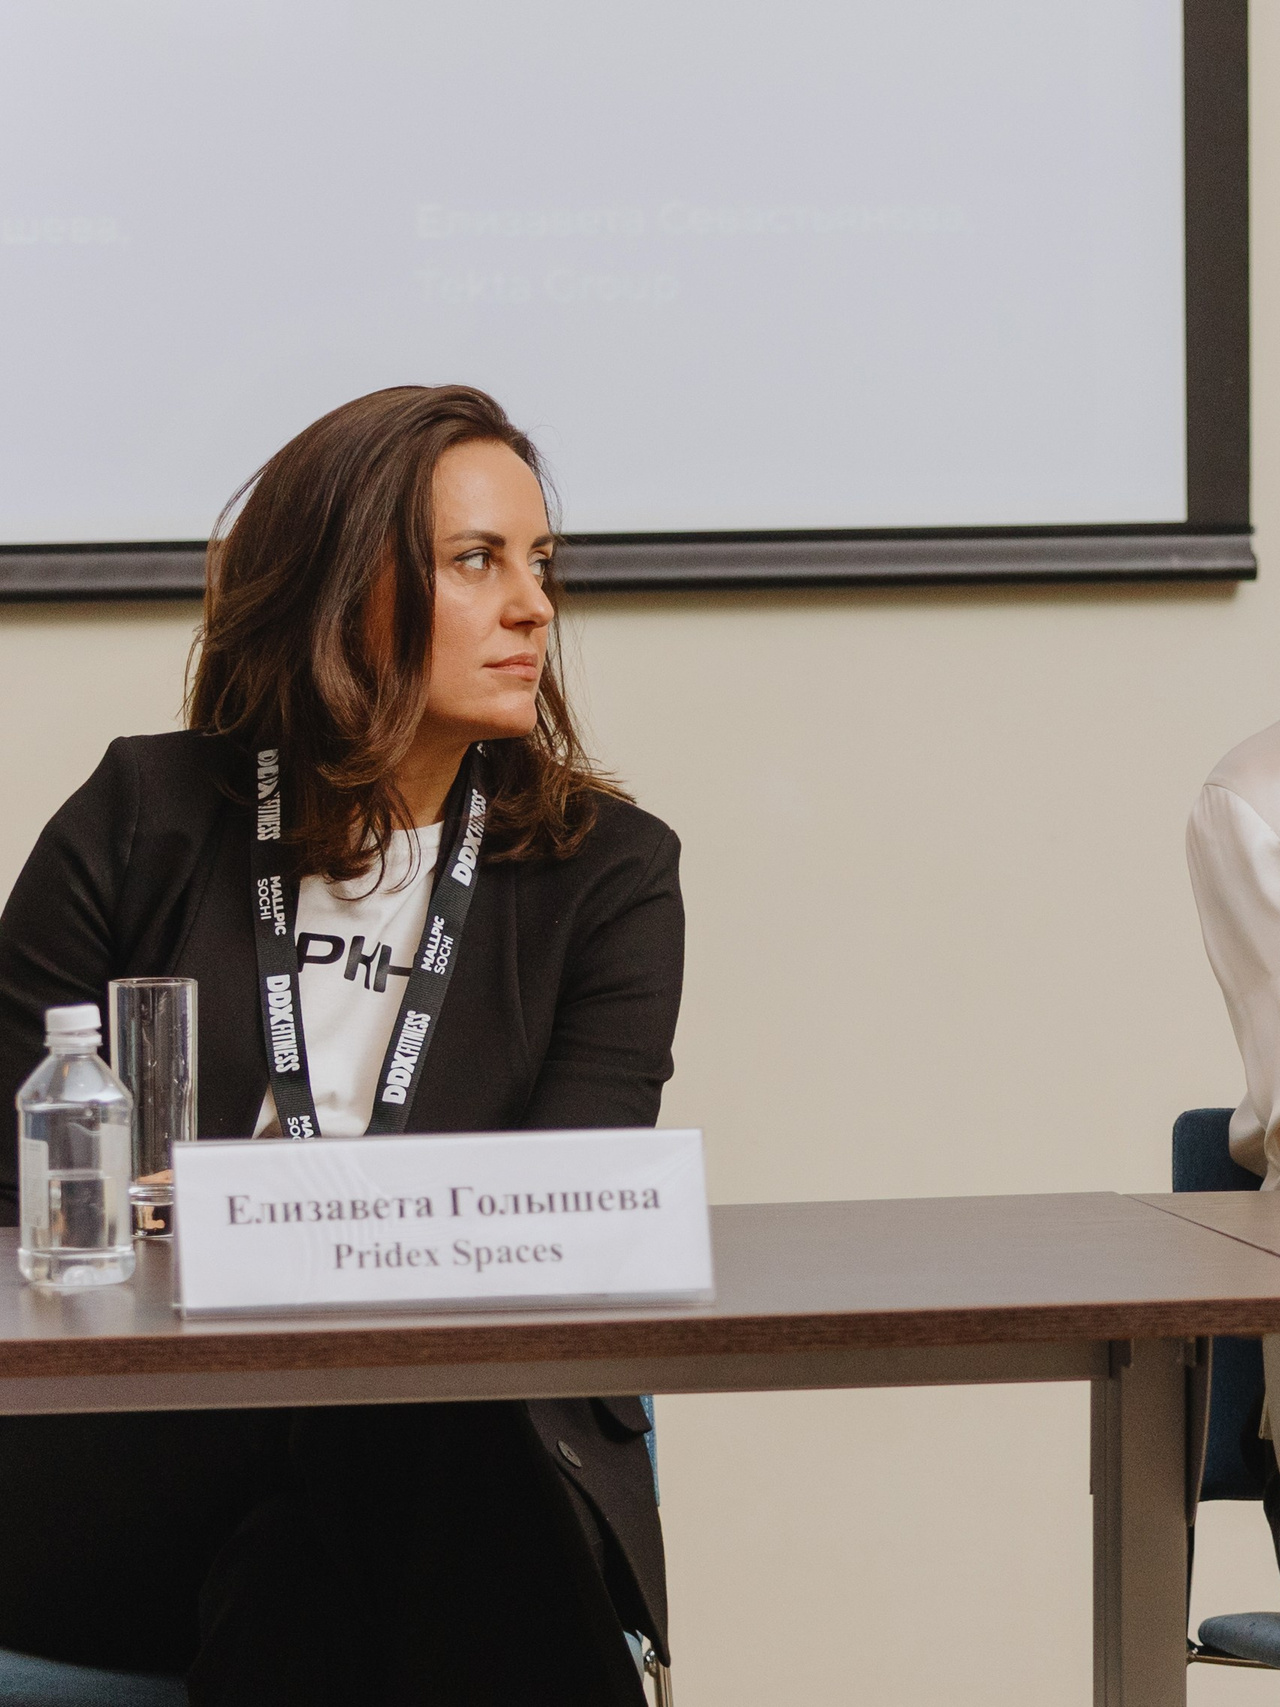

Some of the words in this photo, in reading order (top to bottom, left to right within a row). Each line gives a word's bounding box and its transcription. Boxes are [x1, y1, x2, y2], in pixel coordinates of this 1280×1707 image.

[257, 878, 272, 920] SOCHI
[270, 875, 287, 936] MALLPIC
[420, 915, 445, 971] MALLPIC
[433, 934, 454, 975] SOCHI
[227, 1195, 434, 1225] Елизавета
[448, 1187, 661, 1218] Голышева
[333, 1243, 440, 1270] Pridex
[453, 1239, 564, 1272] Spaces
